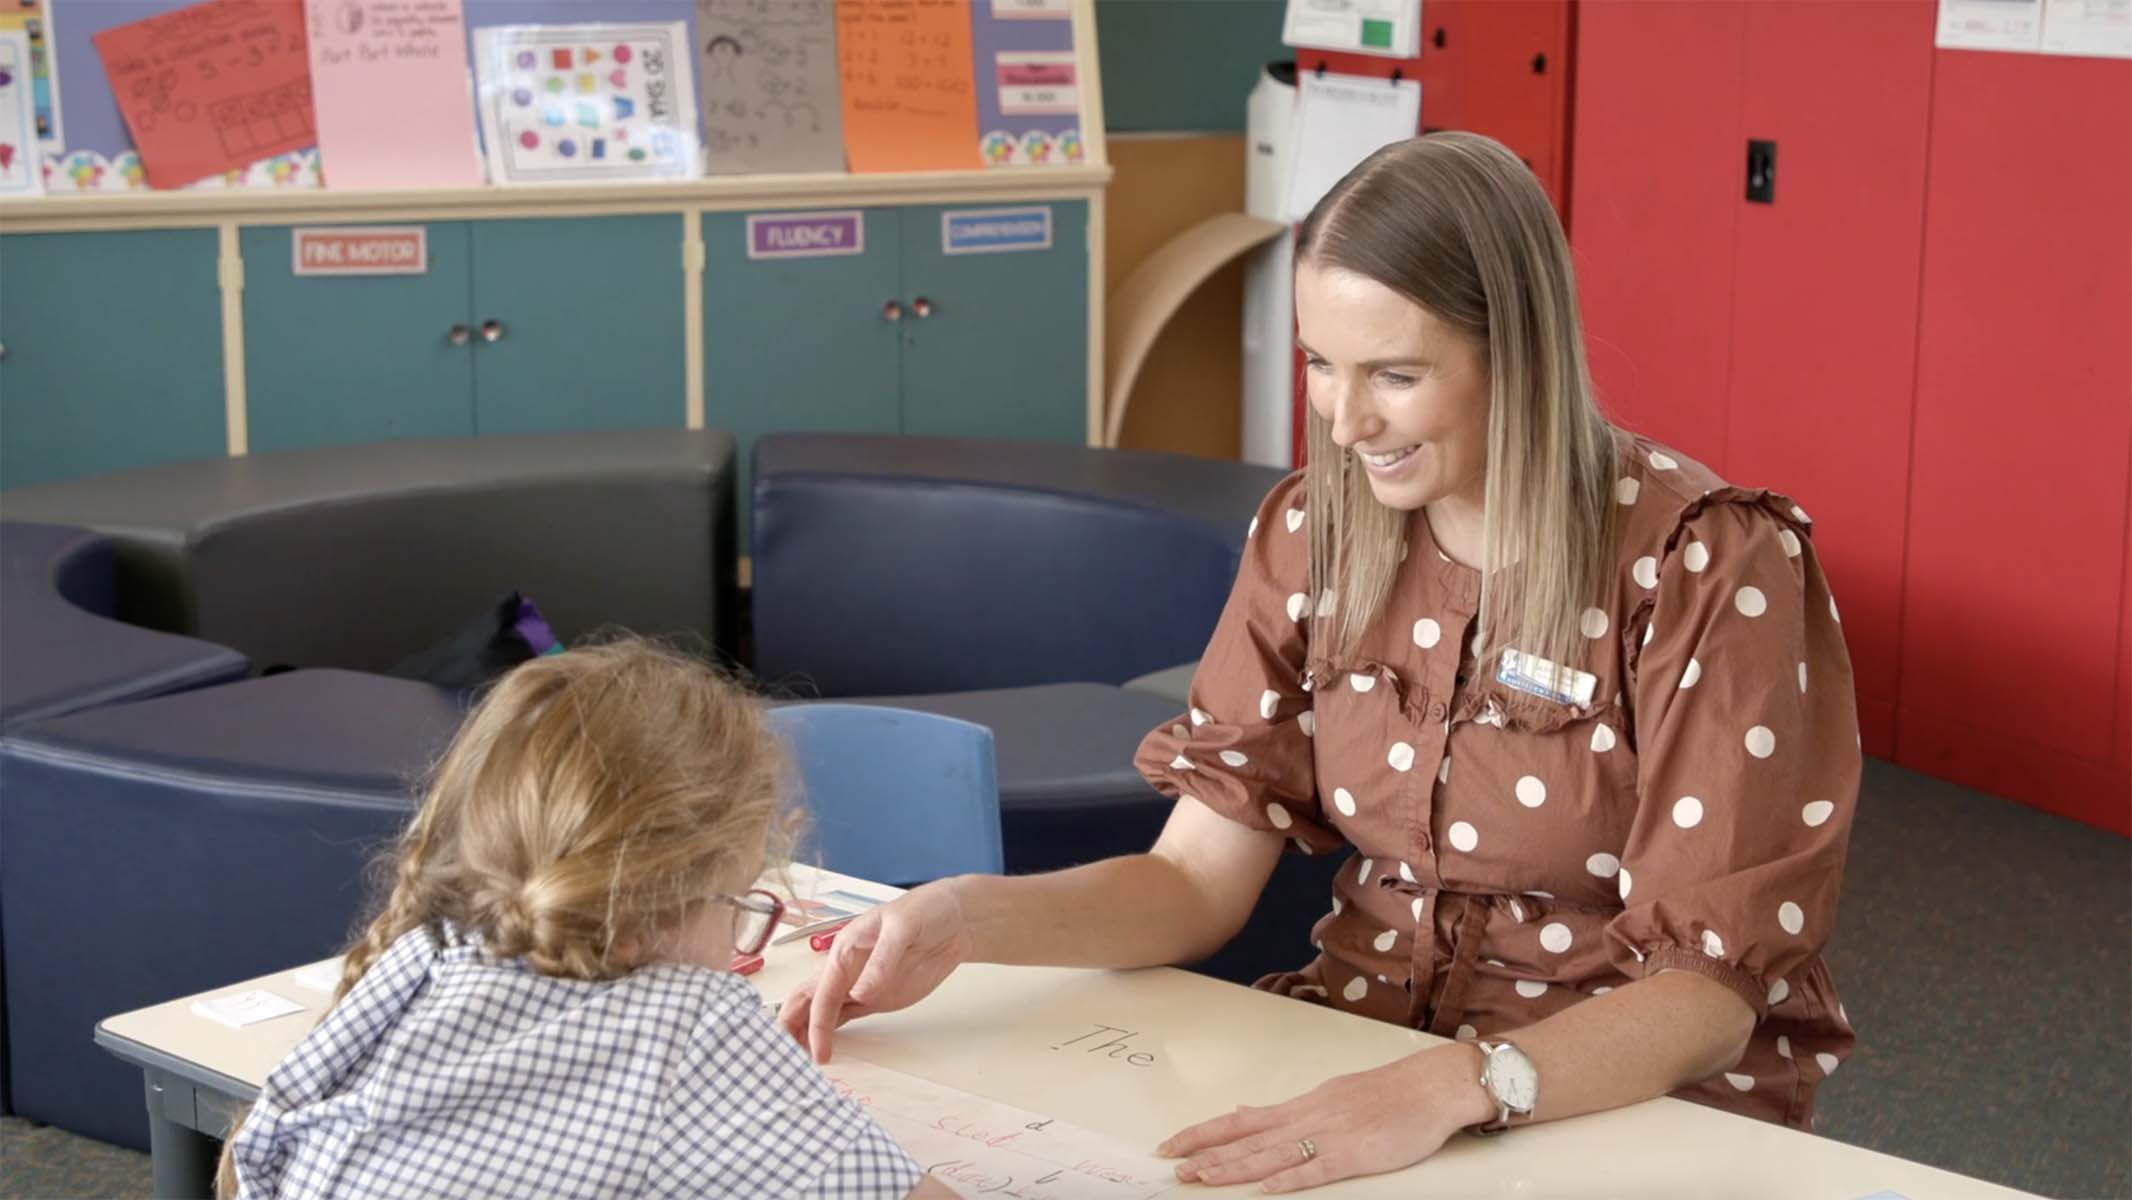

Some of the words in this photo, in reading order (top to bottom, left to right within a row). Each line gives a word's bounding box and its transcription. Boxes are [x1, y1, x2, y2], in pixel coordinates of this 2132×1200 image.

[642, 48, 665, 75] 2D
[765, 225, 845, 249] FLUENCY
[302, 240, 345, 265] FINE
[348, 239, 416, 265] MOTOR
[1062, 1023, 1154, 1067] The
